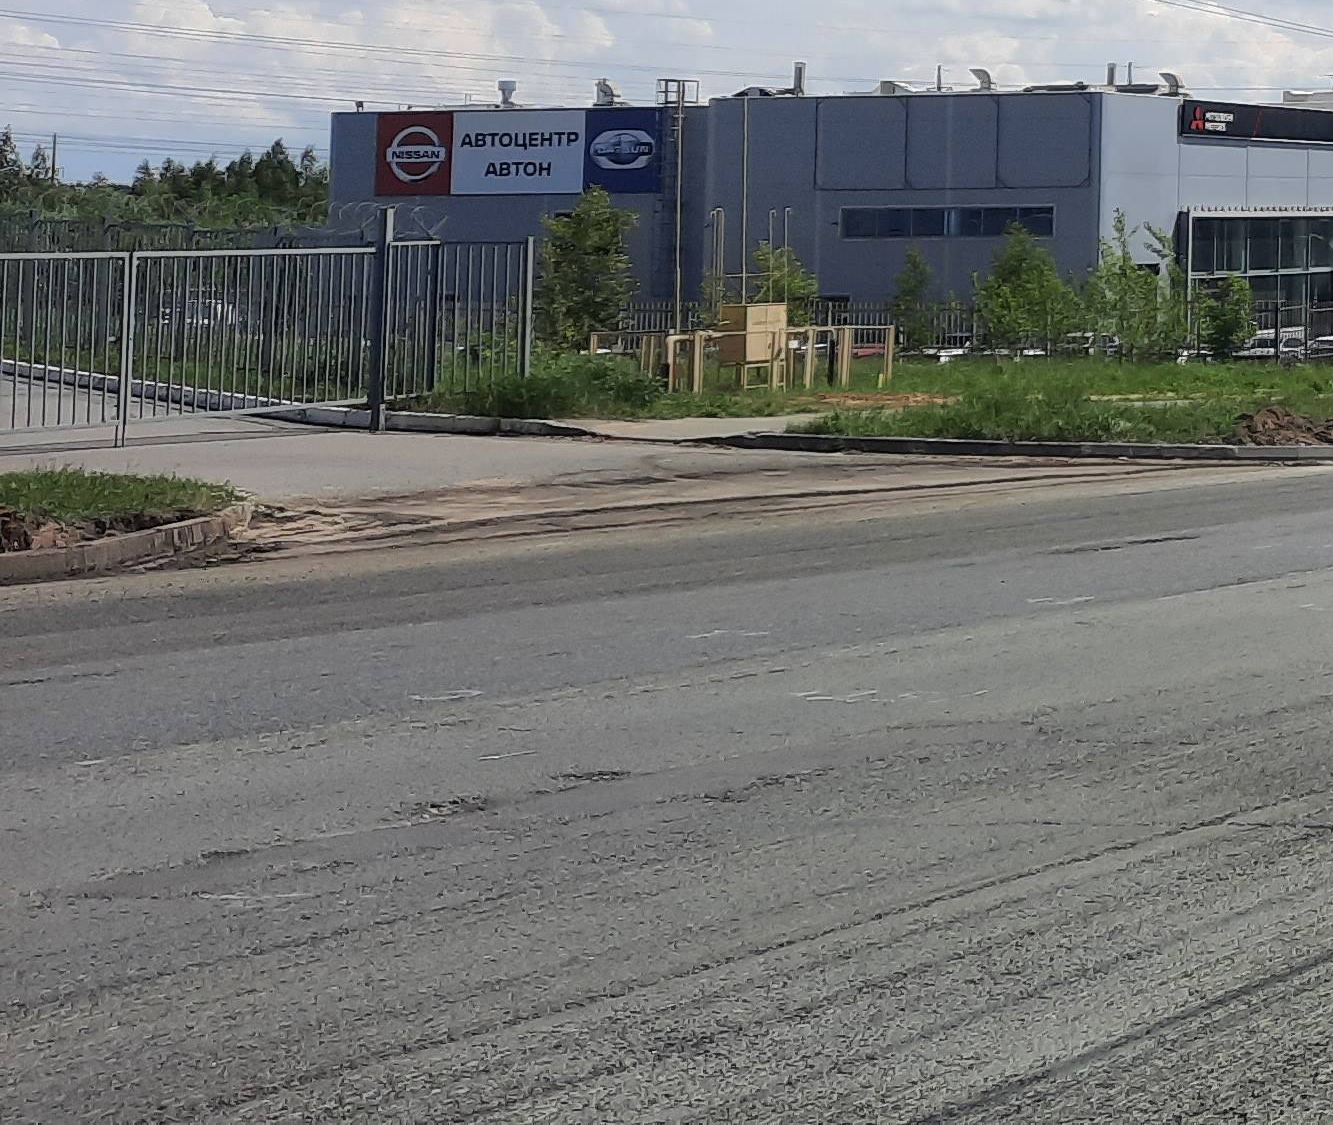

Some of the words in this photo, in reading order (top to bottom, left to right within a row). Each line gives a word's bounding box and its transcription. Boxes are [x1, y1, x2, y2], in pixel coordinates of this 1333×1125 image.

[460, 131, 580, 151] АВТОЦЕНТР
[391, 150, 441, 160] NISSAN
[484, 161, 552, 178] АВТОН
